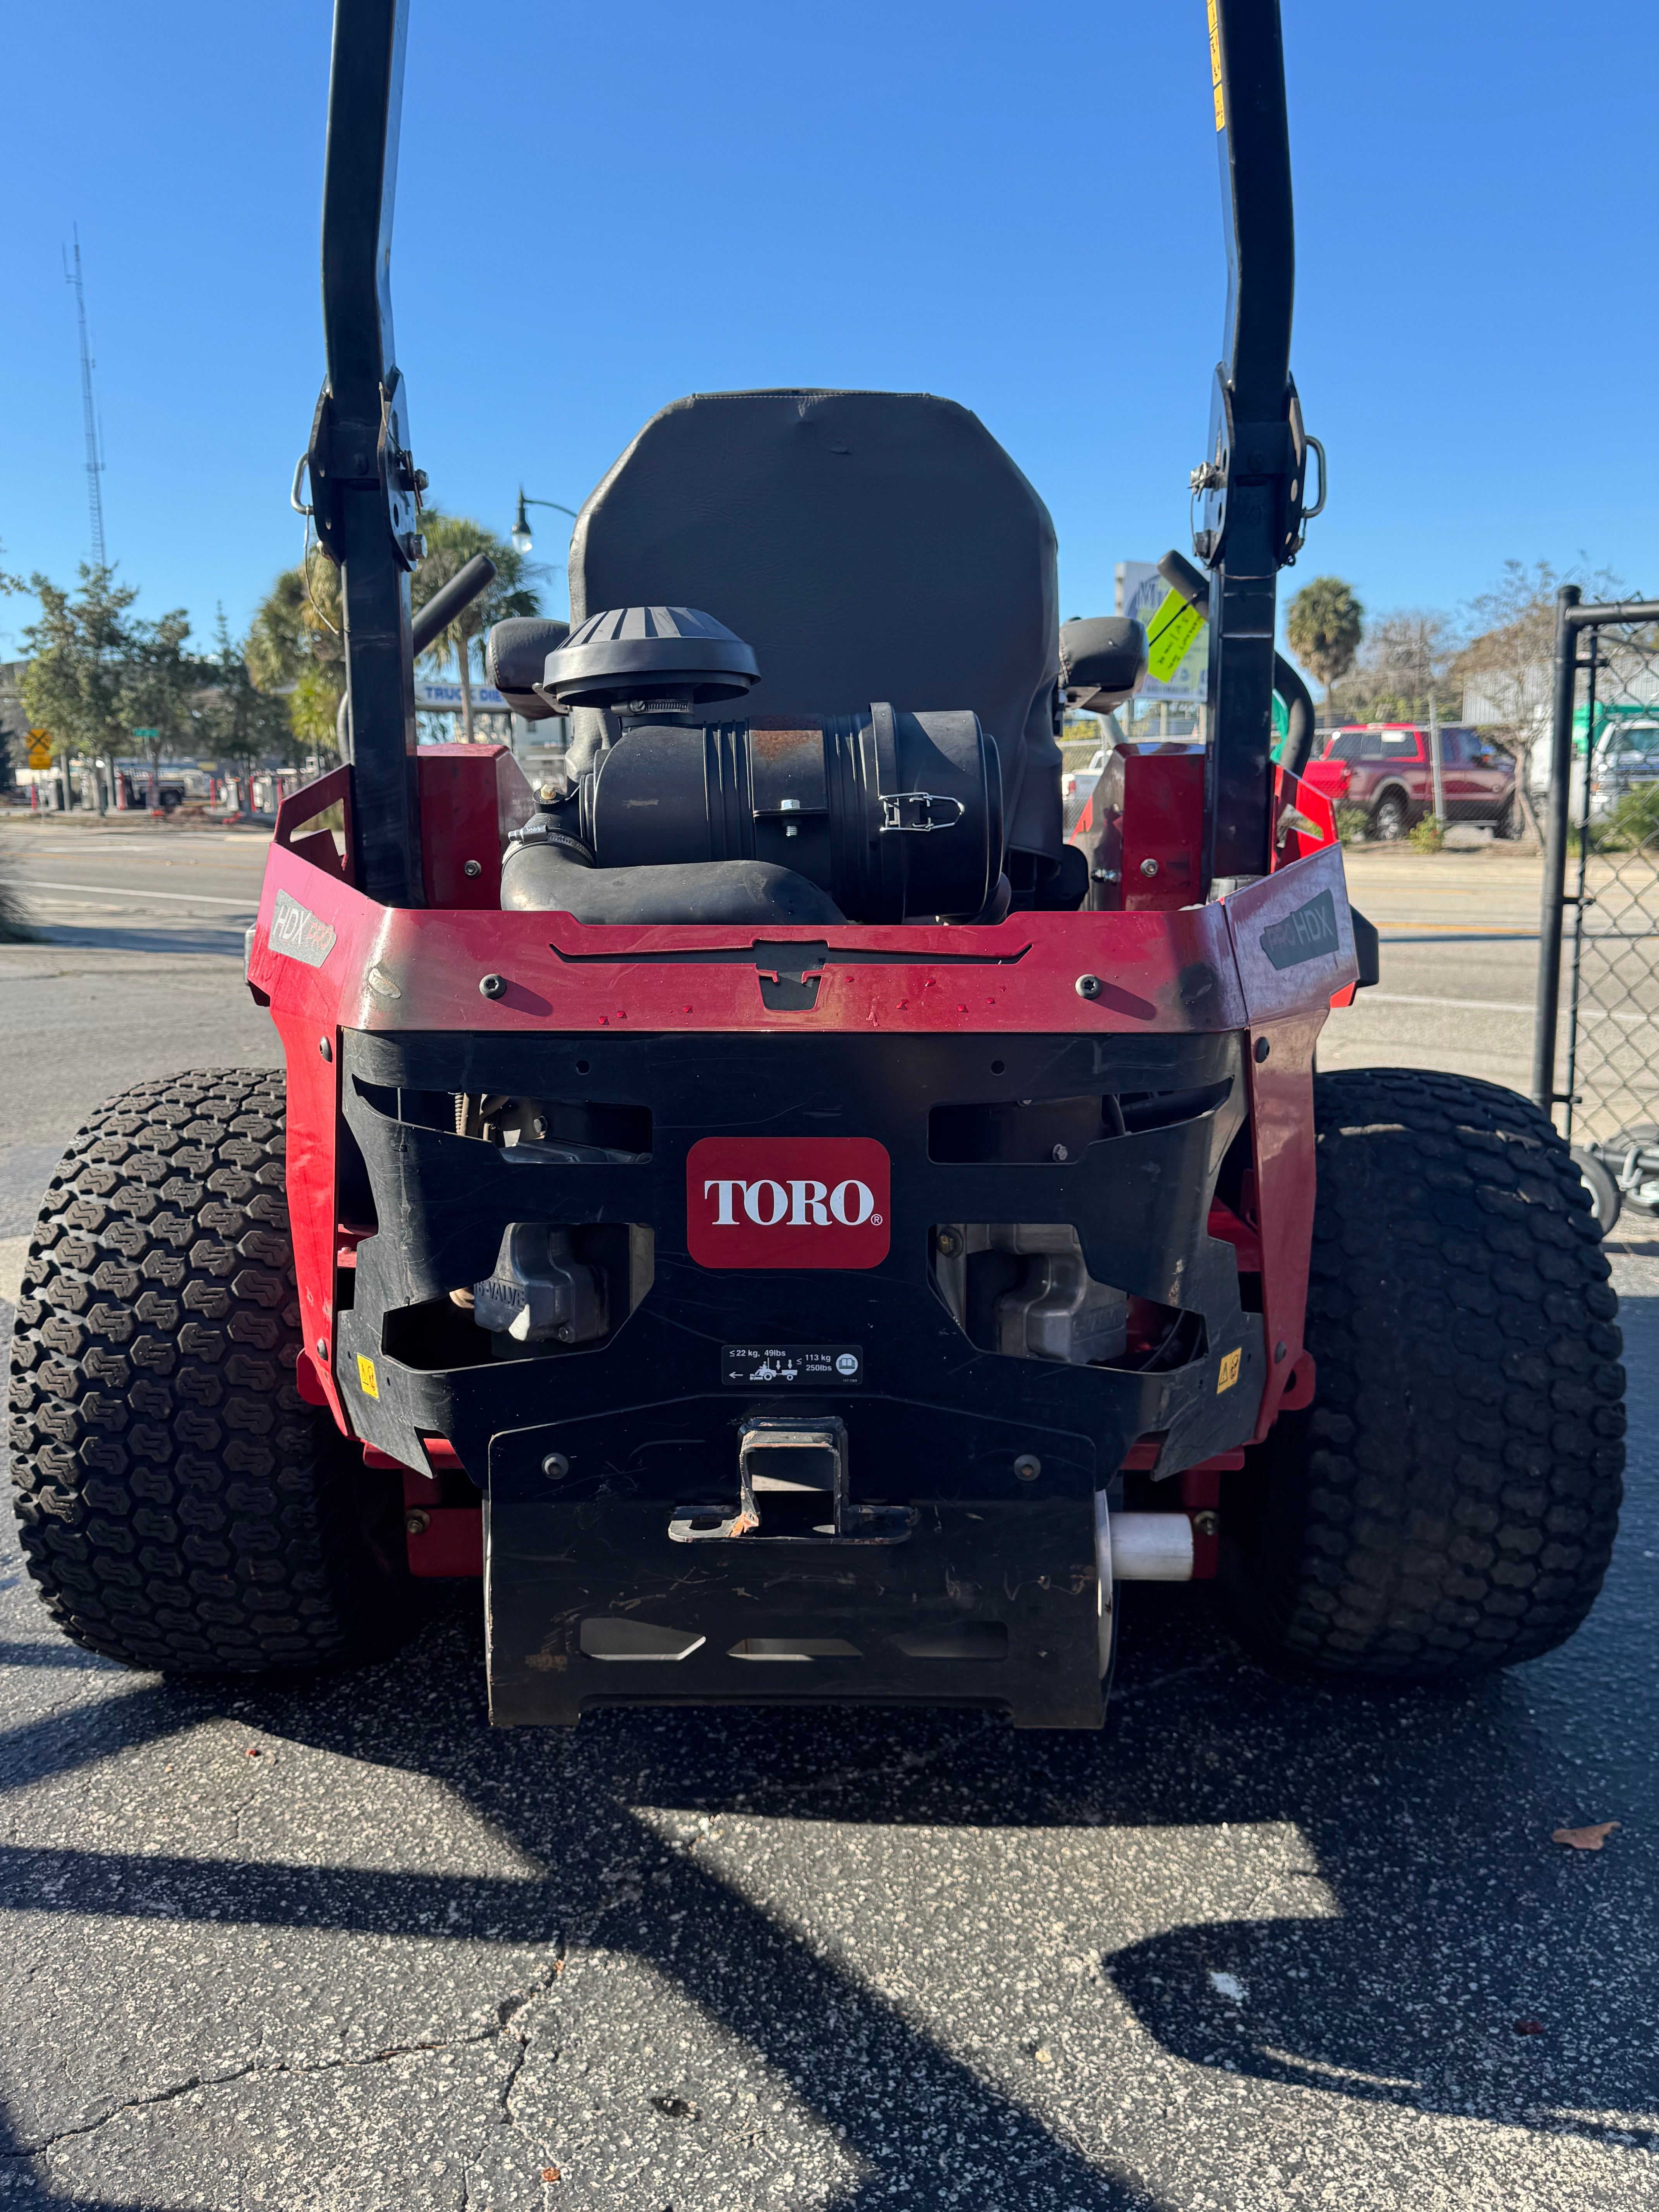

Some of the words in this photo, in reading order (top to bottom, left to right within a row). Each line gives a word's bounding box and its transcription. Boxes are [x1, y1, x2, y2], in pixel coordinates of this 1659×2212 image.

[273, 905, 311, 945] HDX
[1292, 906, 1333, 945] HDX
[821, 1354, 831, 1362] kg
